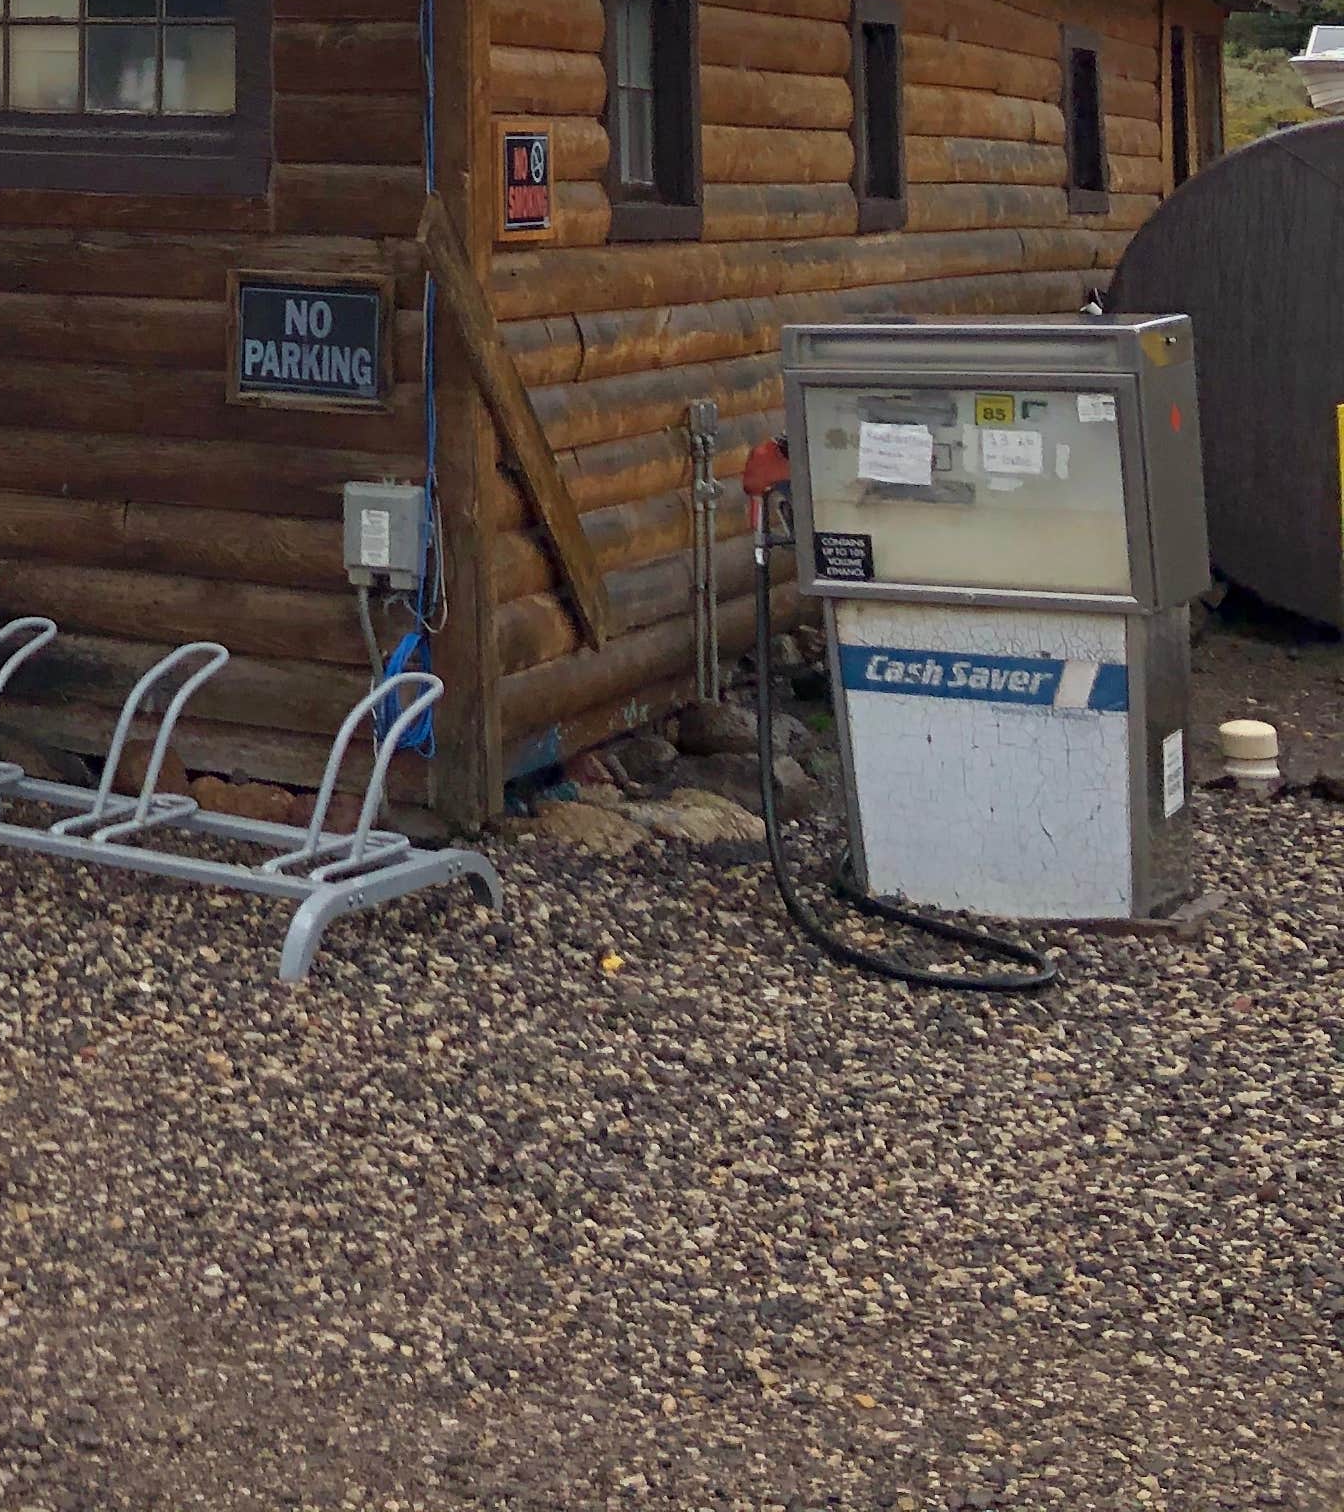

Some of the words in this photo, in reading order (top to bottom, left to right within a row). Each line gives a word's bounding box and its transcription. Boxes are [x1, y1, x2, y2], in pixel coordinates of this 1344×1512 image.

[285, 298, 333, 339] NO
[244, 338, 372, 385] PARKING
[983, 407, 1006, 421] 85
[822, 547, 834, 556] UP
[835, 548, 848, 557] TO
[864, 654, 944, 687] Cash
[946, 660, 1054, 695] Saver
